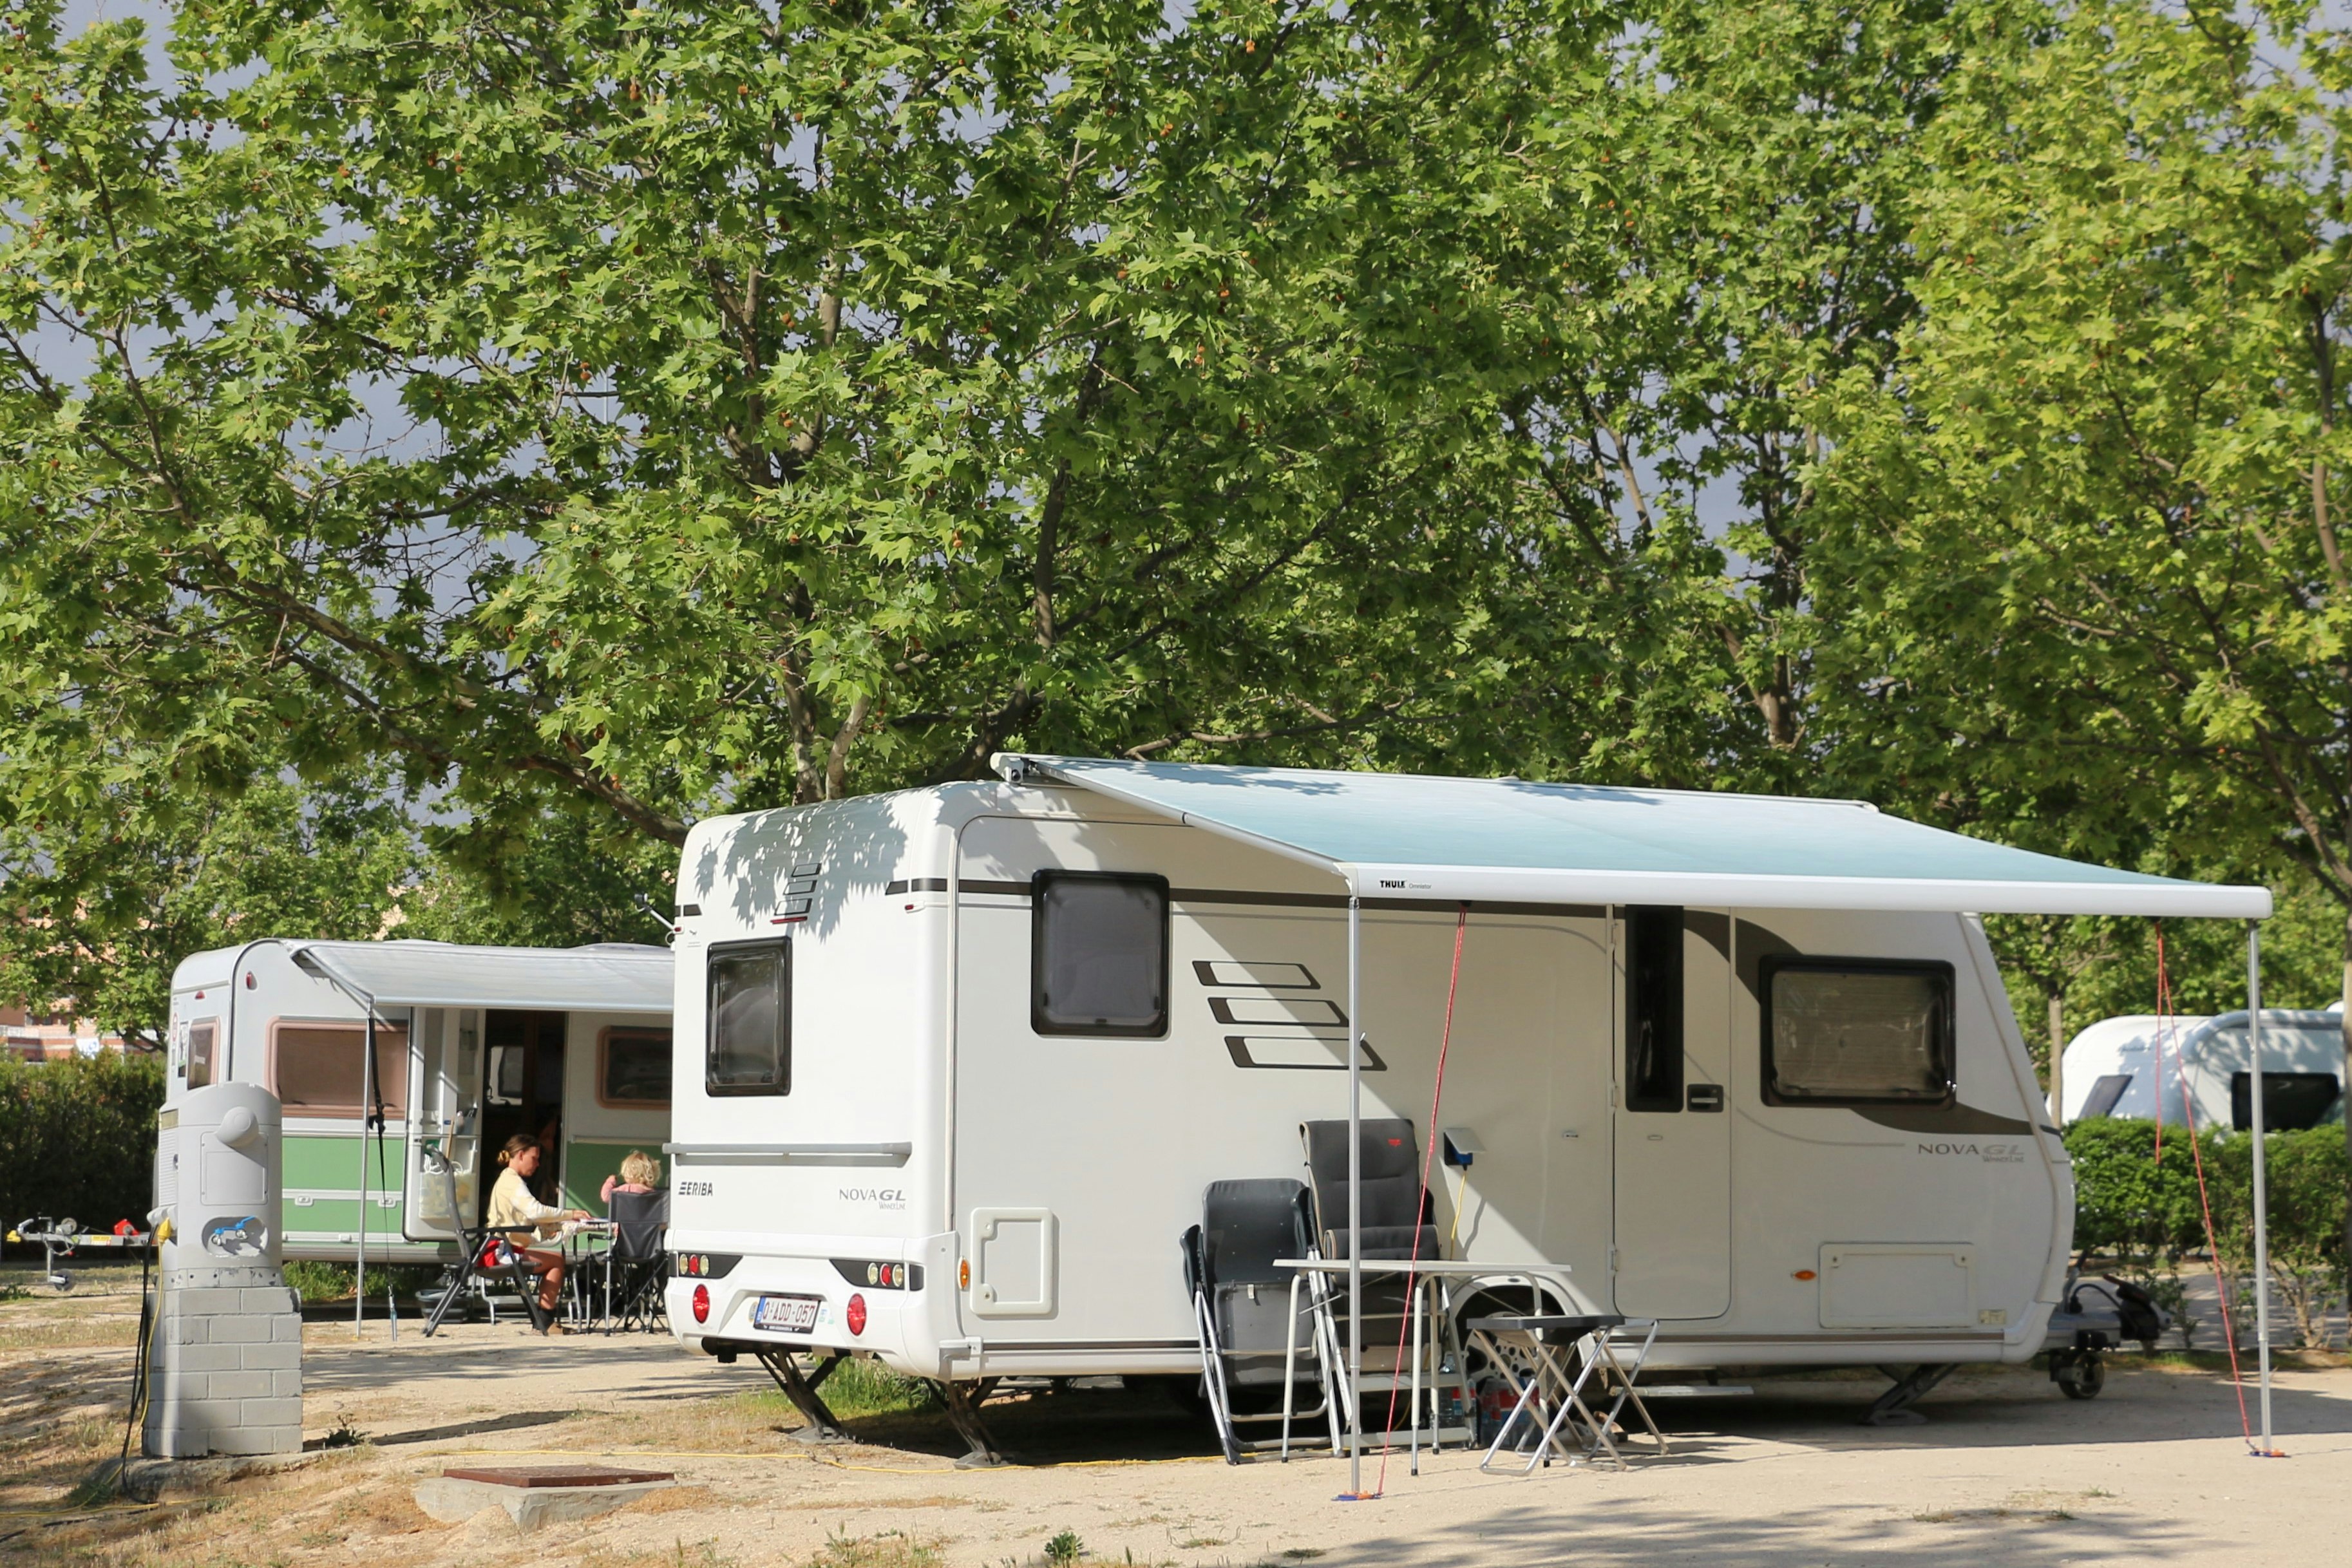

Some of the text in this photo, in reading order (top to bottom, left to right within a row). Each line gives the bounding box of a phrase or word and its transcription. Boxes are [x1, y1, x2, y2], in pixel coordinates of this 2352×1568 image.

[1380, 880, 1406, 889] THULE
[1918, 1144, 2025, 1155] NOVA GL
[686, 1182, 713, 1196] ERIBA
[839, 1188, 906, 1202] NOVA GL
